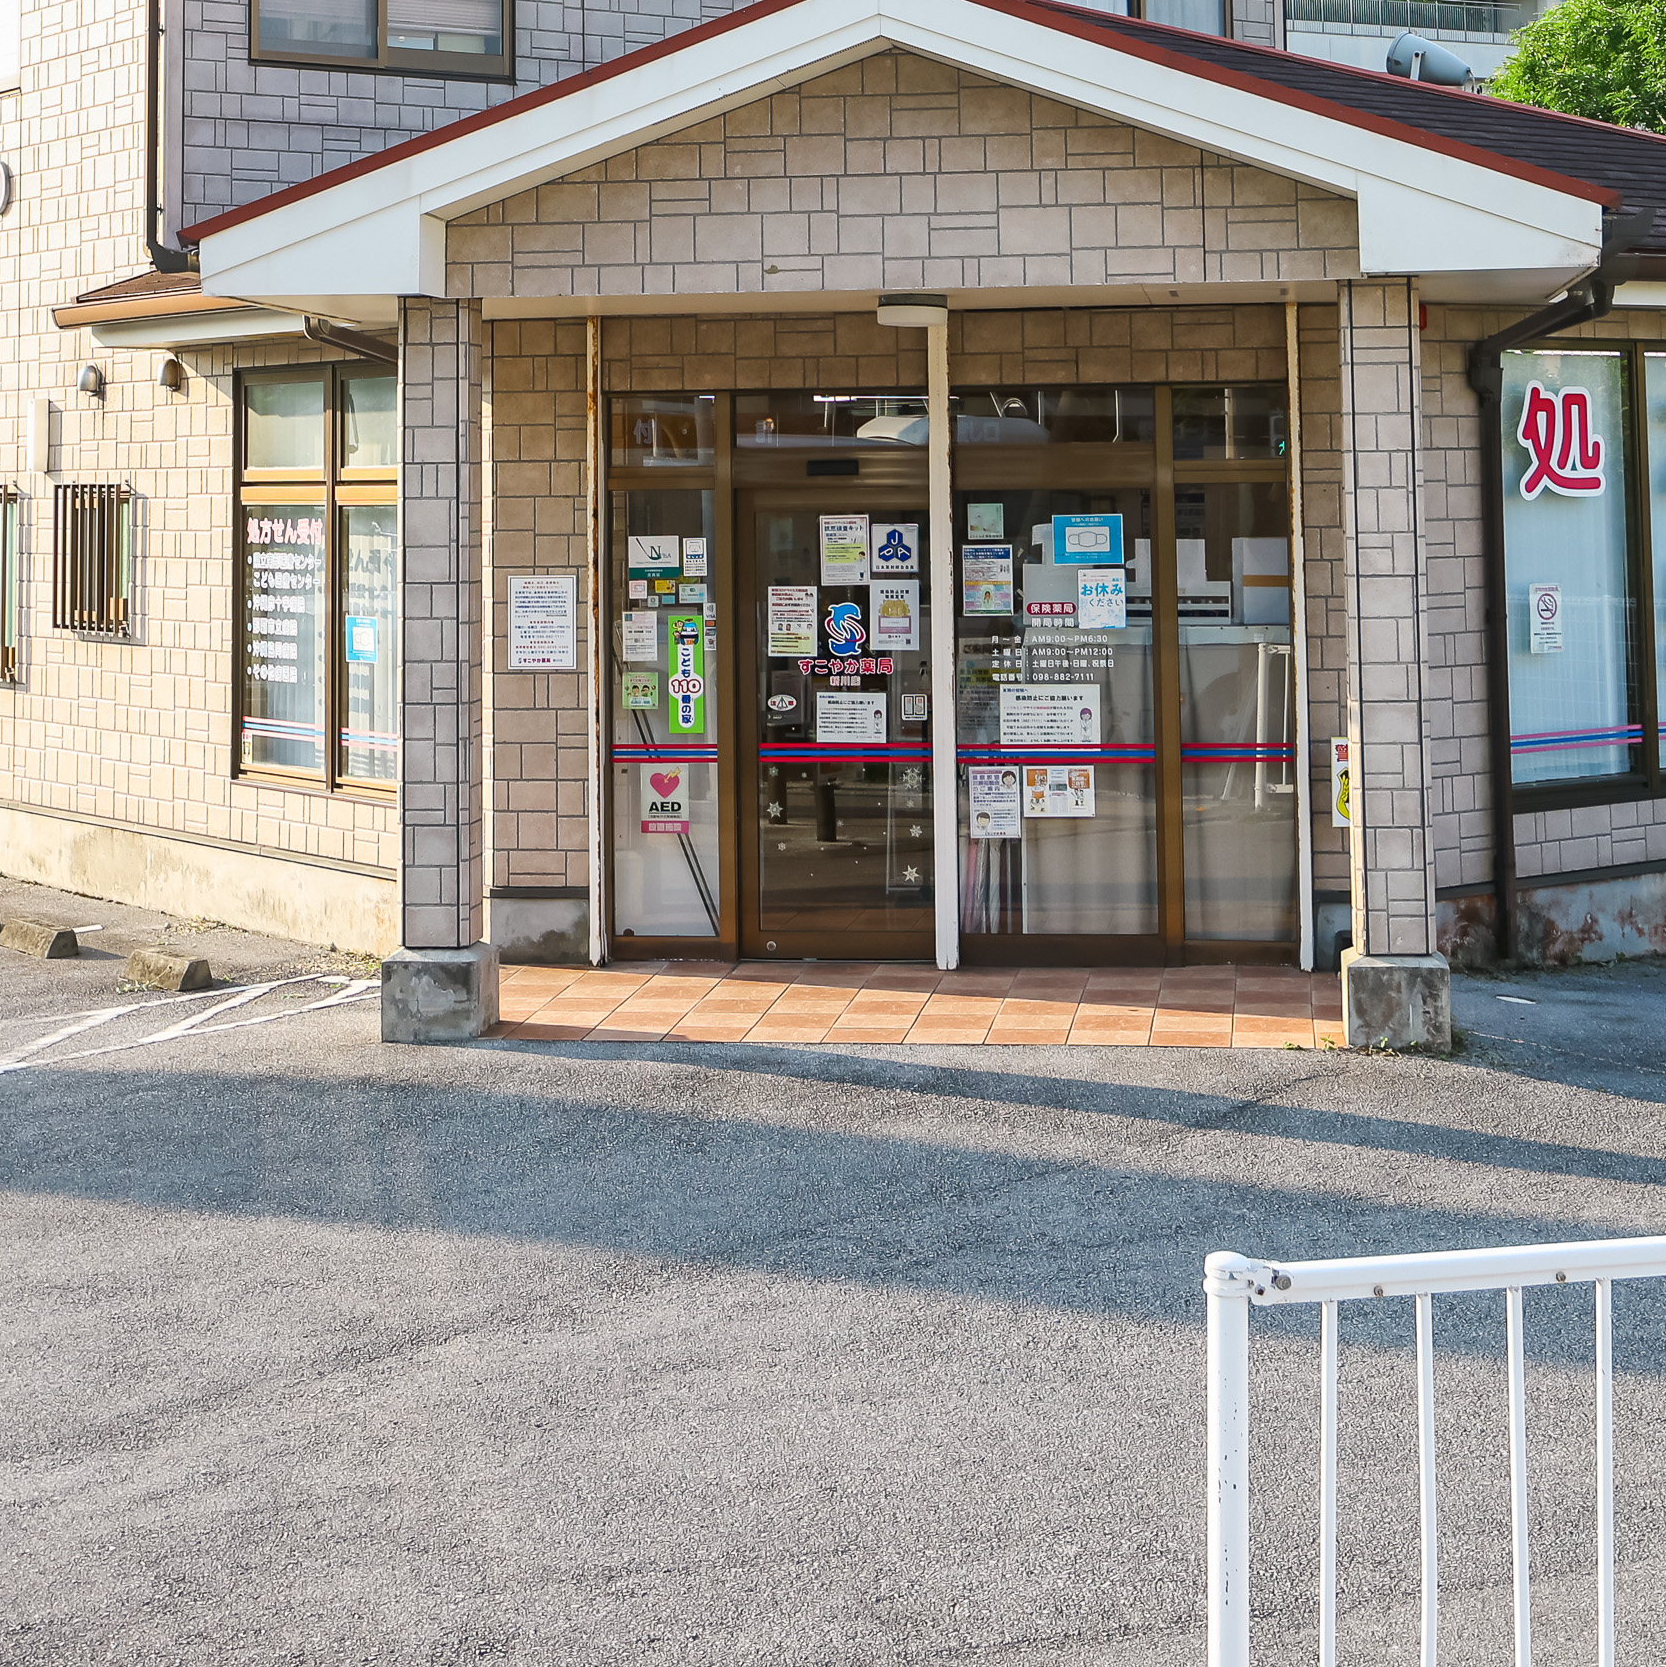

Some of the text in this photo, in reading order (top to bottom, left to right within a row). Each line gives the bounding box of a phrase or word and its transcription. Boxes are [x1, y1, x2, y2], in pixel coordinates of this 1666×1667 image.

[247, 517, 323, 545] 処方せん受付
[1080, 583, 1123, 597] お休み
[1089, 598, 1123, 607] ください
[1031, 603, 1073, 614] 保険薬局
[1032, 618, 1074, 627] 開局時間
[798, 658, 893, 675] すこやか薬局
[649, 802, 681, 812] AED
